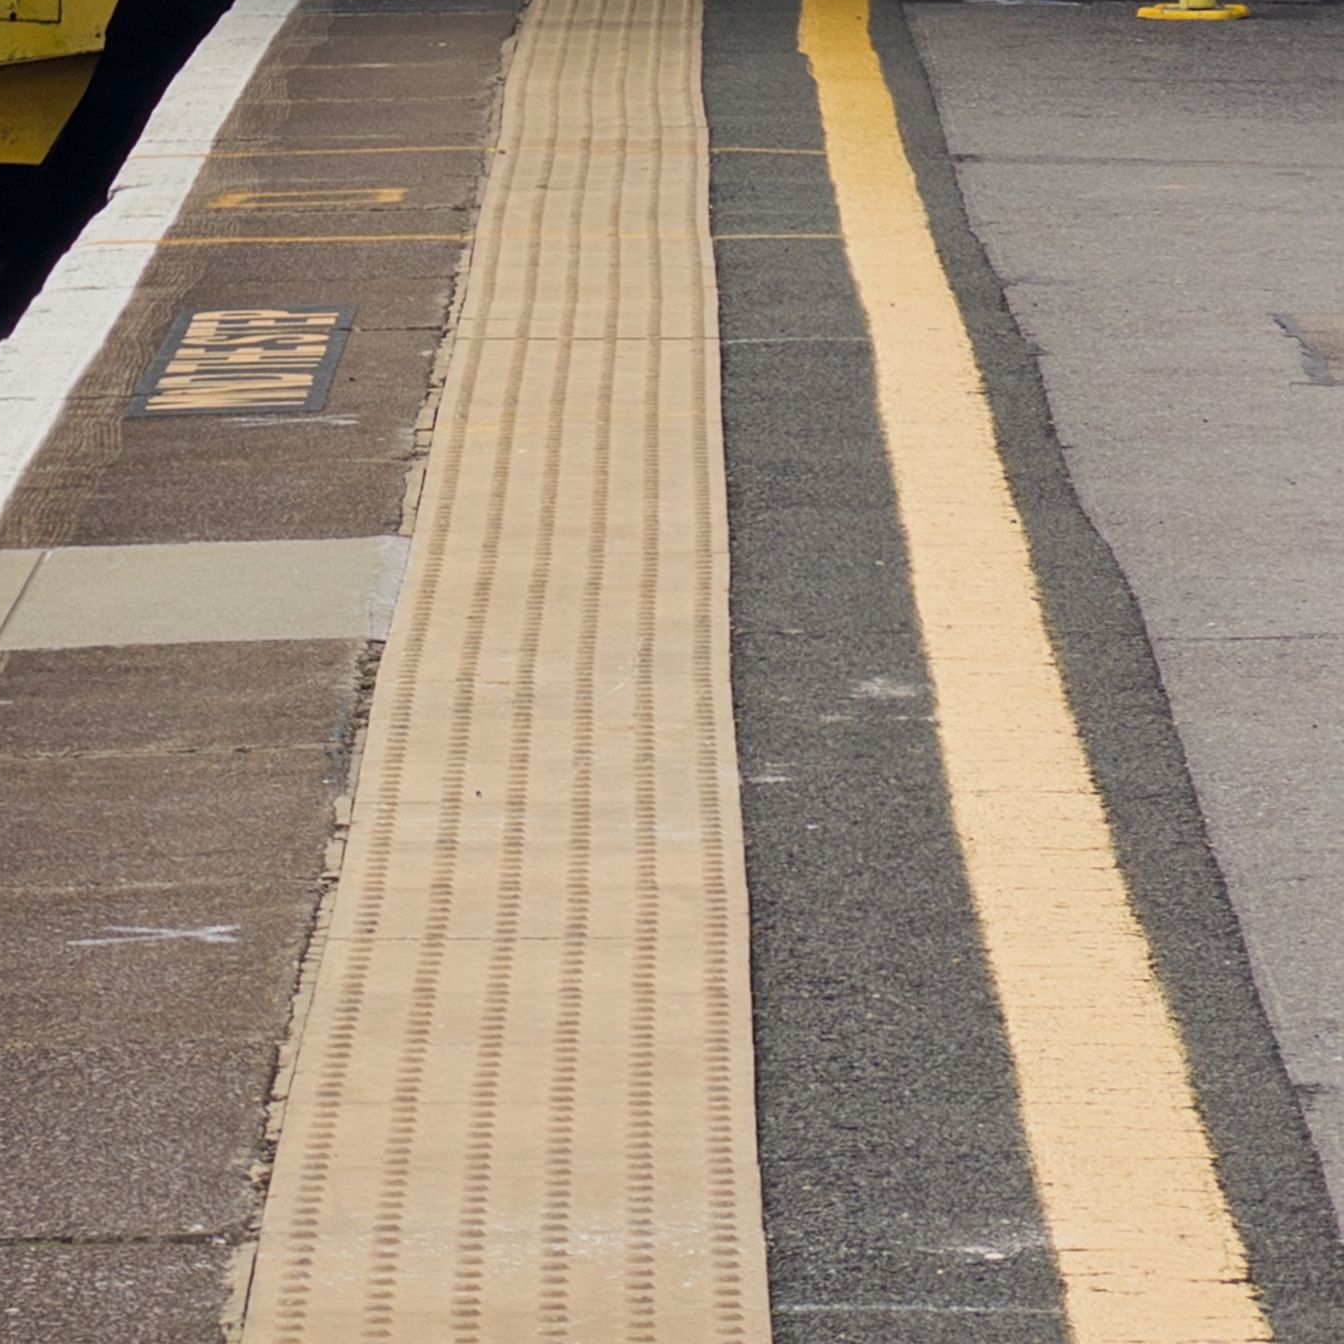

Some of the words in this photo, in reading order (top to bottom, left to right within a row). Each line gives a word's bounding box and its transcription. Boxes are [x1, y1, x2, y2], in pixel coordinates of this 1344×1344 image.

[180, 309, 340, 345] STEP
[164, 344, 327, 374] THE
[145, 372, 314, 410] MIND
